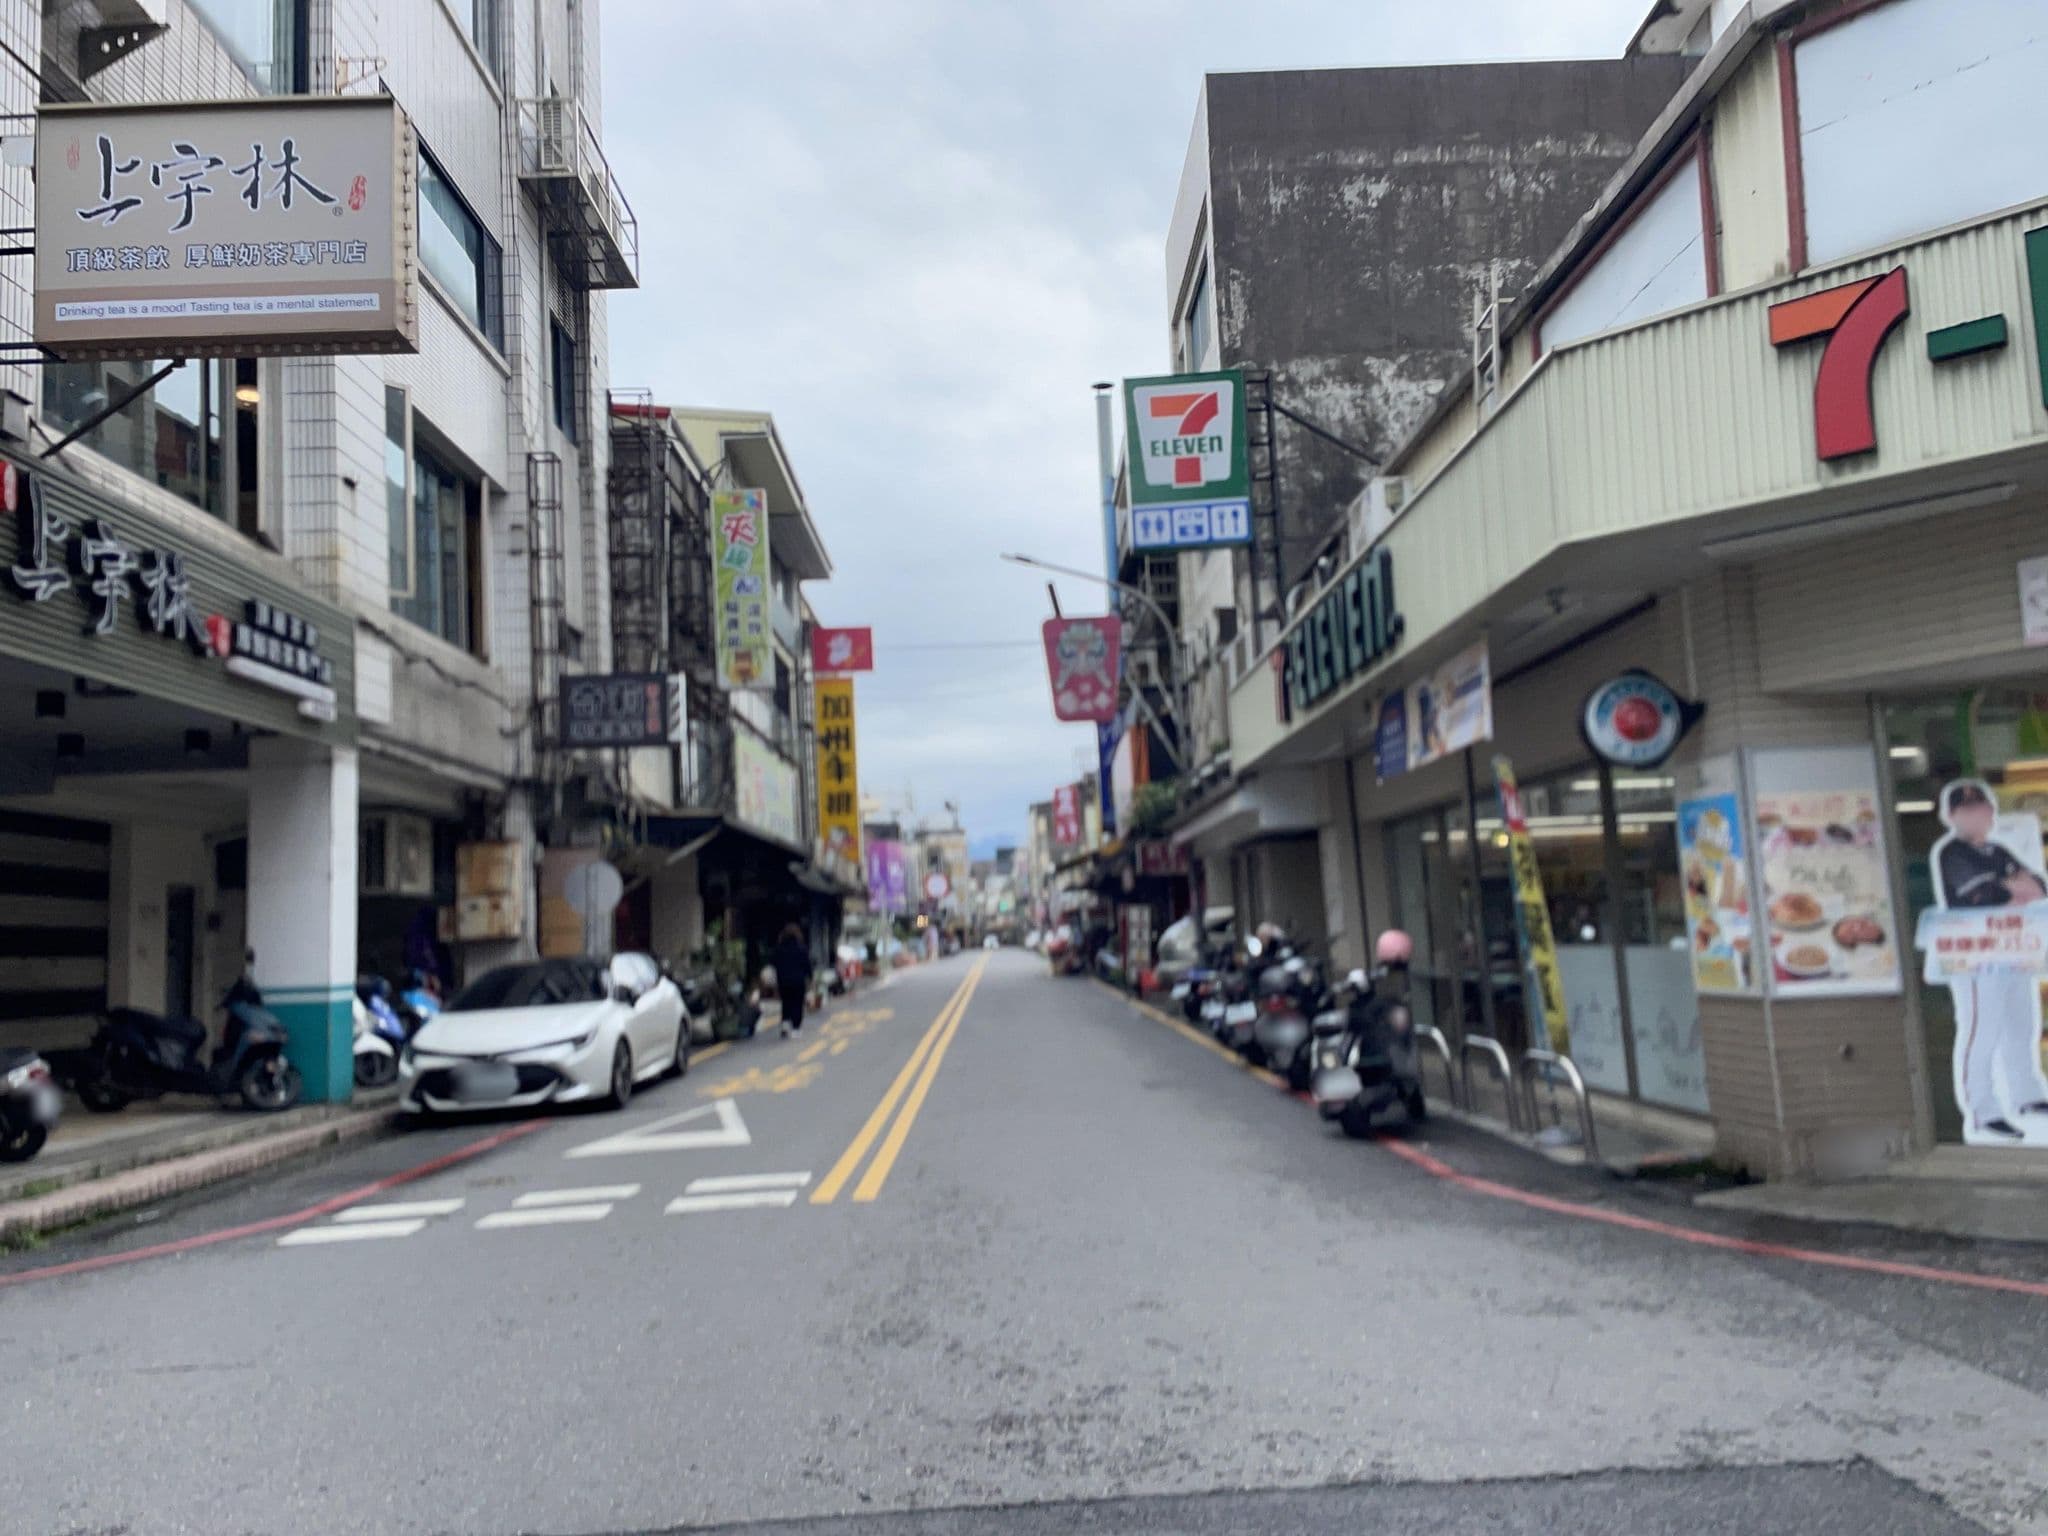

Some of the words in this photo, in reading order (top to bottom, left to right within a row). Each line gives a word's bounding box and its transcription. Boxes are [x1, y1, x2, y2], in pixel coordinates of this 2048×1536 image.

[66, 247, 170, 272] 頂級茶飲
[184, 240, 368, 269] 厚鮮奶茶專門店
[58, 305, 105, 319] Drinking
[108, 304, 125, 315] tea
[128, 303, 138, 314] is
[141, 305, 149, 314] a
[151, 302, 187, 313] mood!
[190, 301, 230, 314] Tasting
[233, 301, 251, 312] tea
[253, 300, 263, 311] is
[266, 301, 274, 311] a
[276, 298, 315, 310] mental
[318, 296, 377, 309] statement.
[1150, 391, 1219, 484] 7
